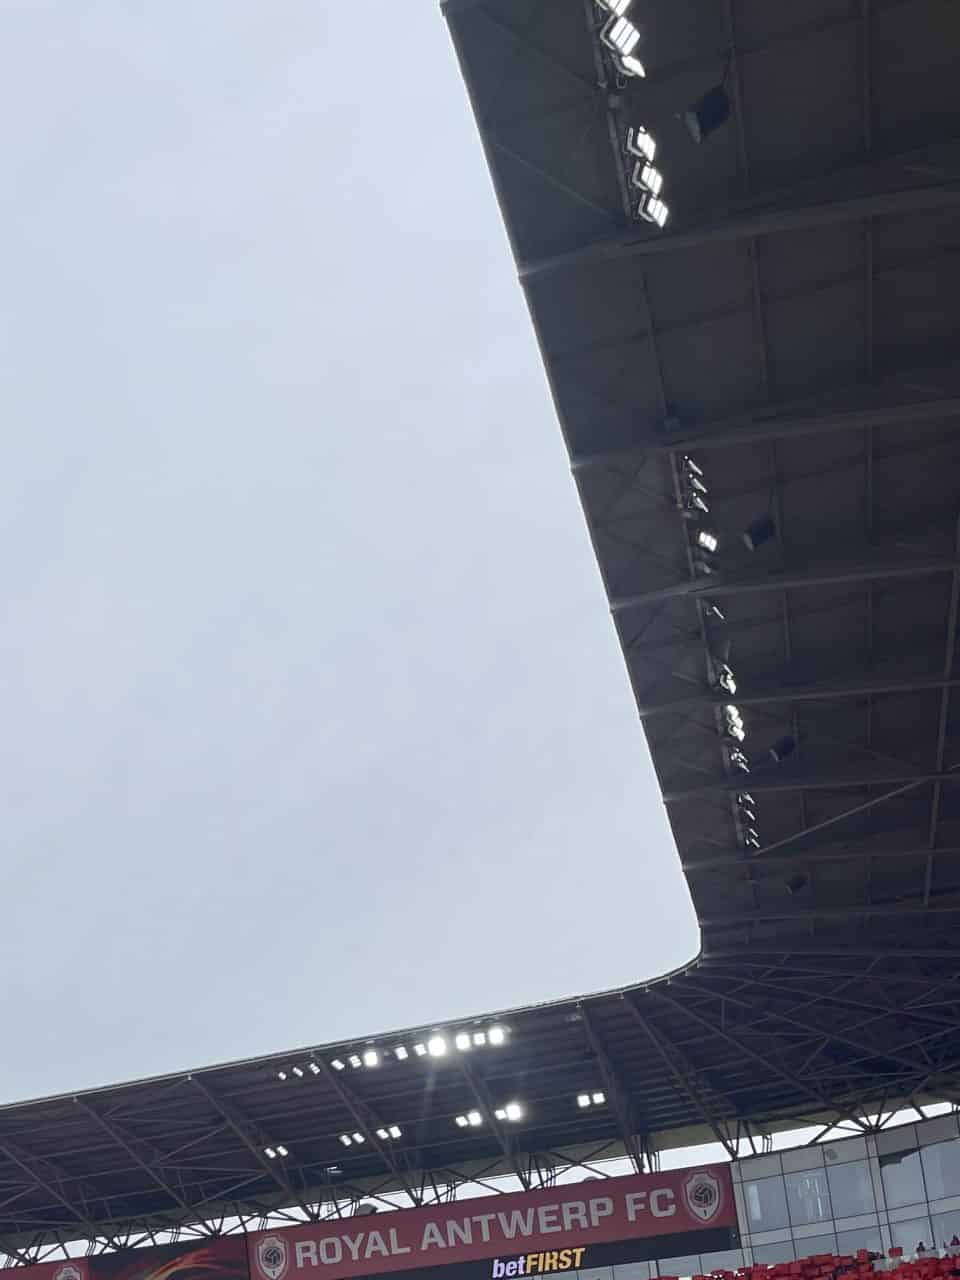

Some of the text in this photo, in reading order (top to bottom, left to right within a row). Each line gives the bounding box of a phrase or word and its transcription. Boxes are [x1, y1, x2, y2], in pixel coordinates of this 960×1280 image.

[295, 1188, 677, 1269] ROYAL ANTWERP FC
[492, 1247, 587, 1279] betFIRST
